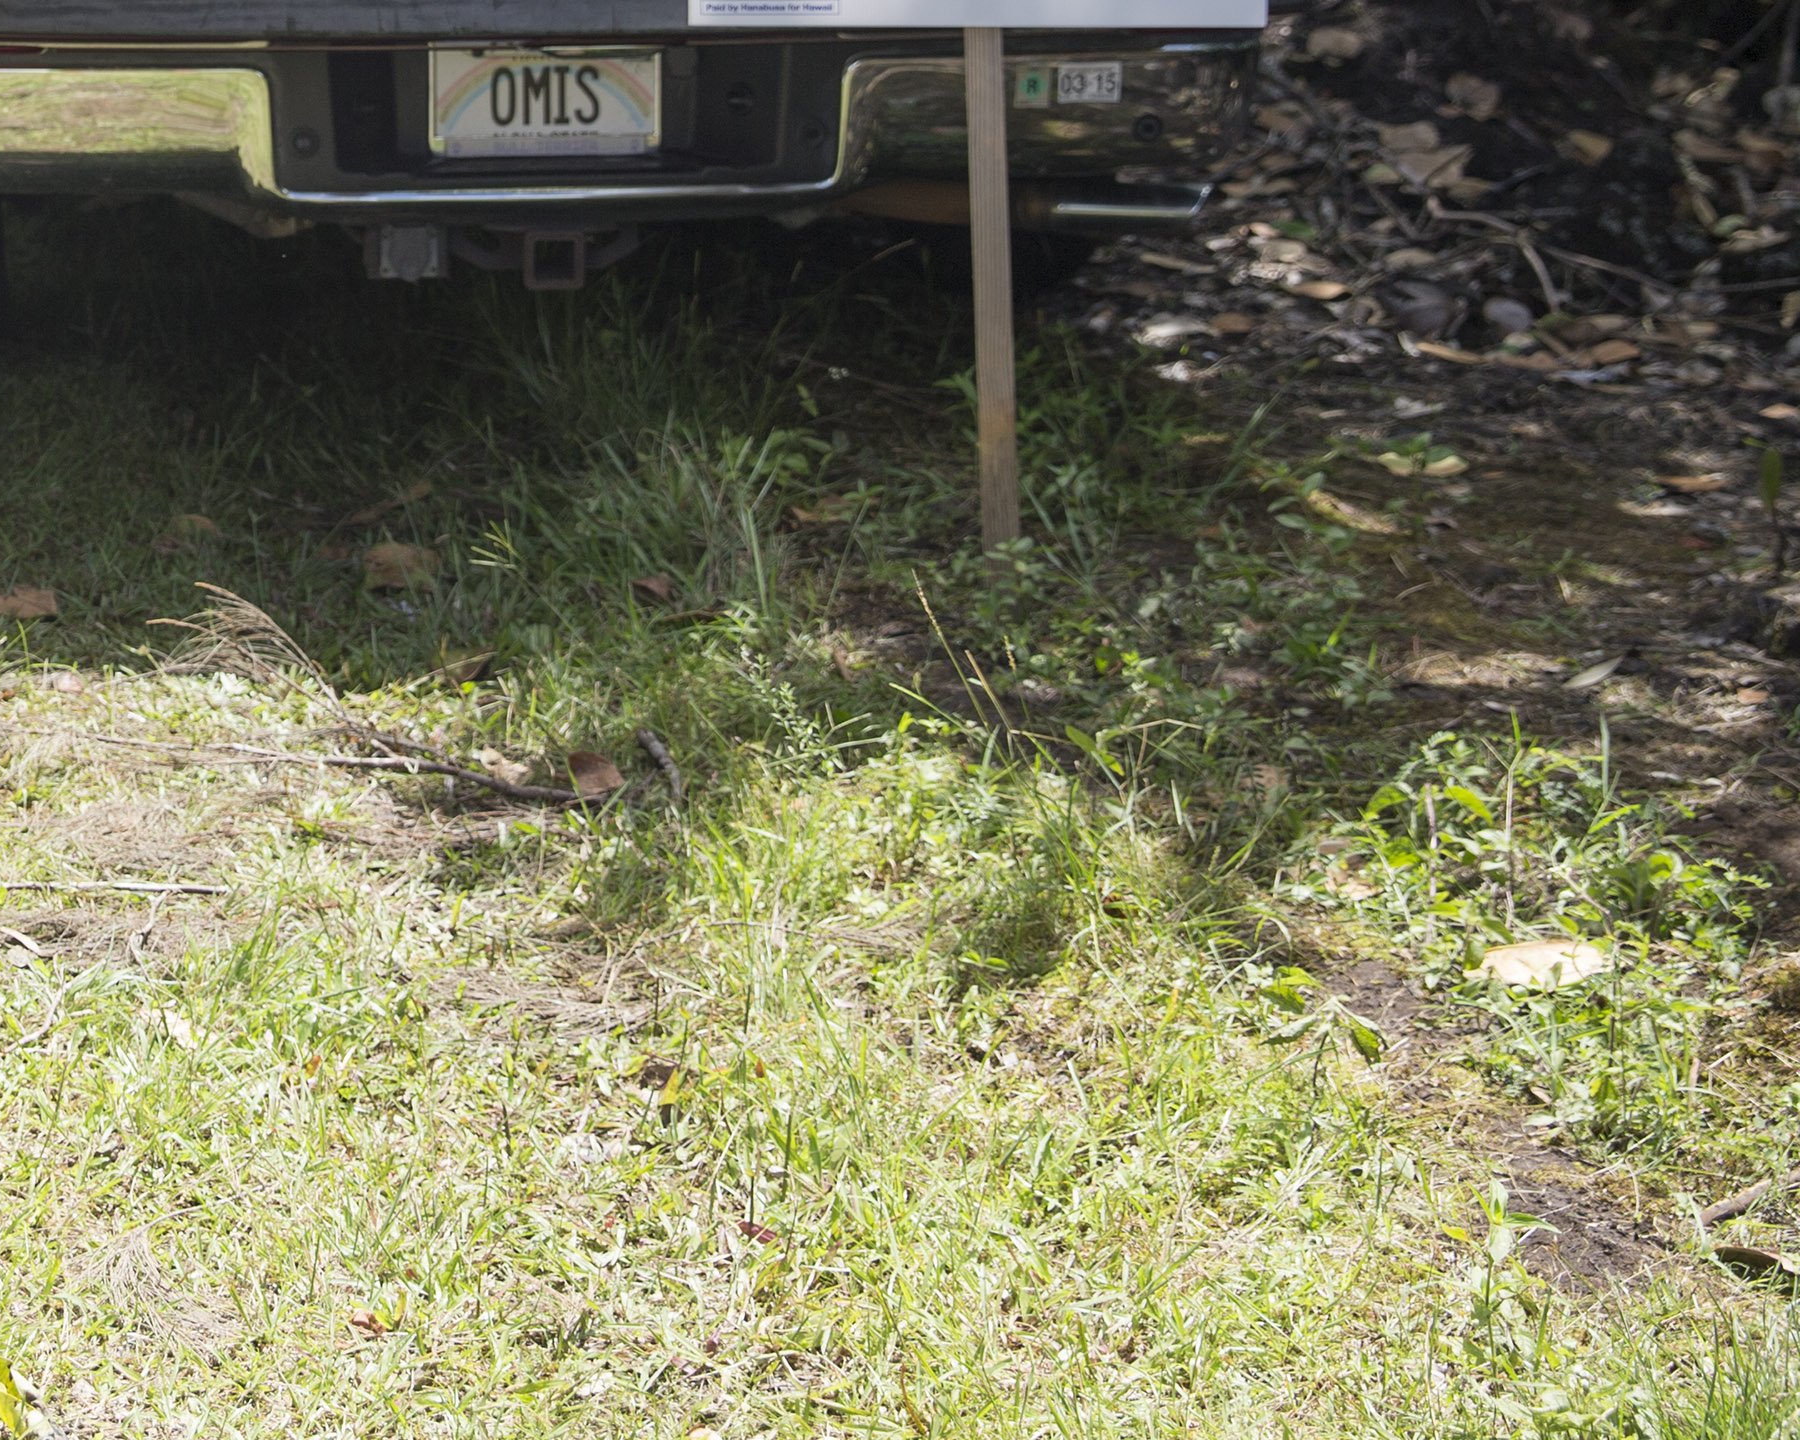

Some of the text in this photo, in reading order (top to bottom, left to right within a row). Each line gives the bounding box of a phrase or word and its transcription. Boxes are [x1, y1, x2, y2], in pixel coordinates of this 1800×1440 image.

[706, 3, 725, 12] Paid
[727, 3, 738, 13] by
[787, 3, 799, 12] for
[491, 66, 600, 126] OMIS
